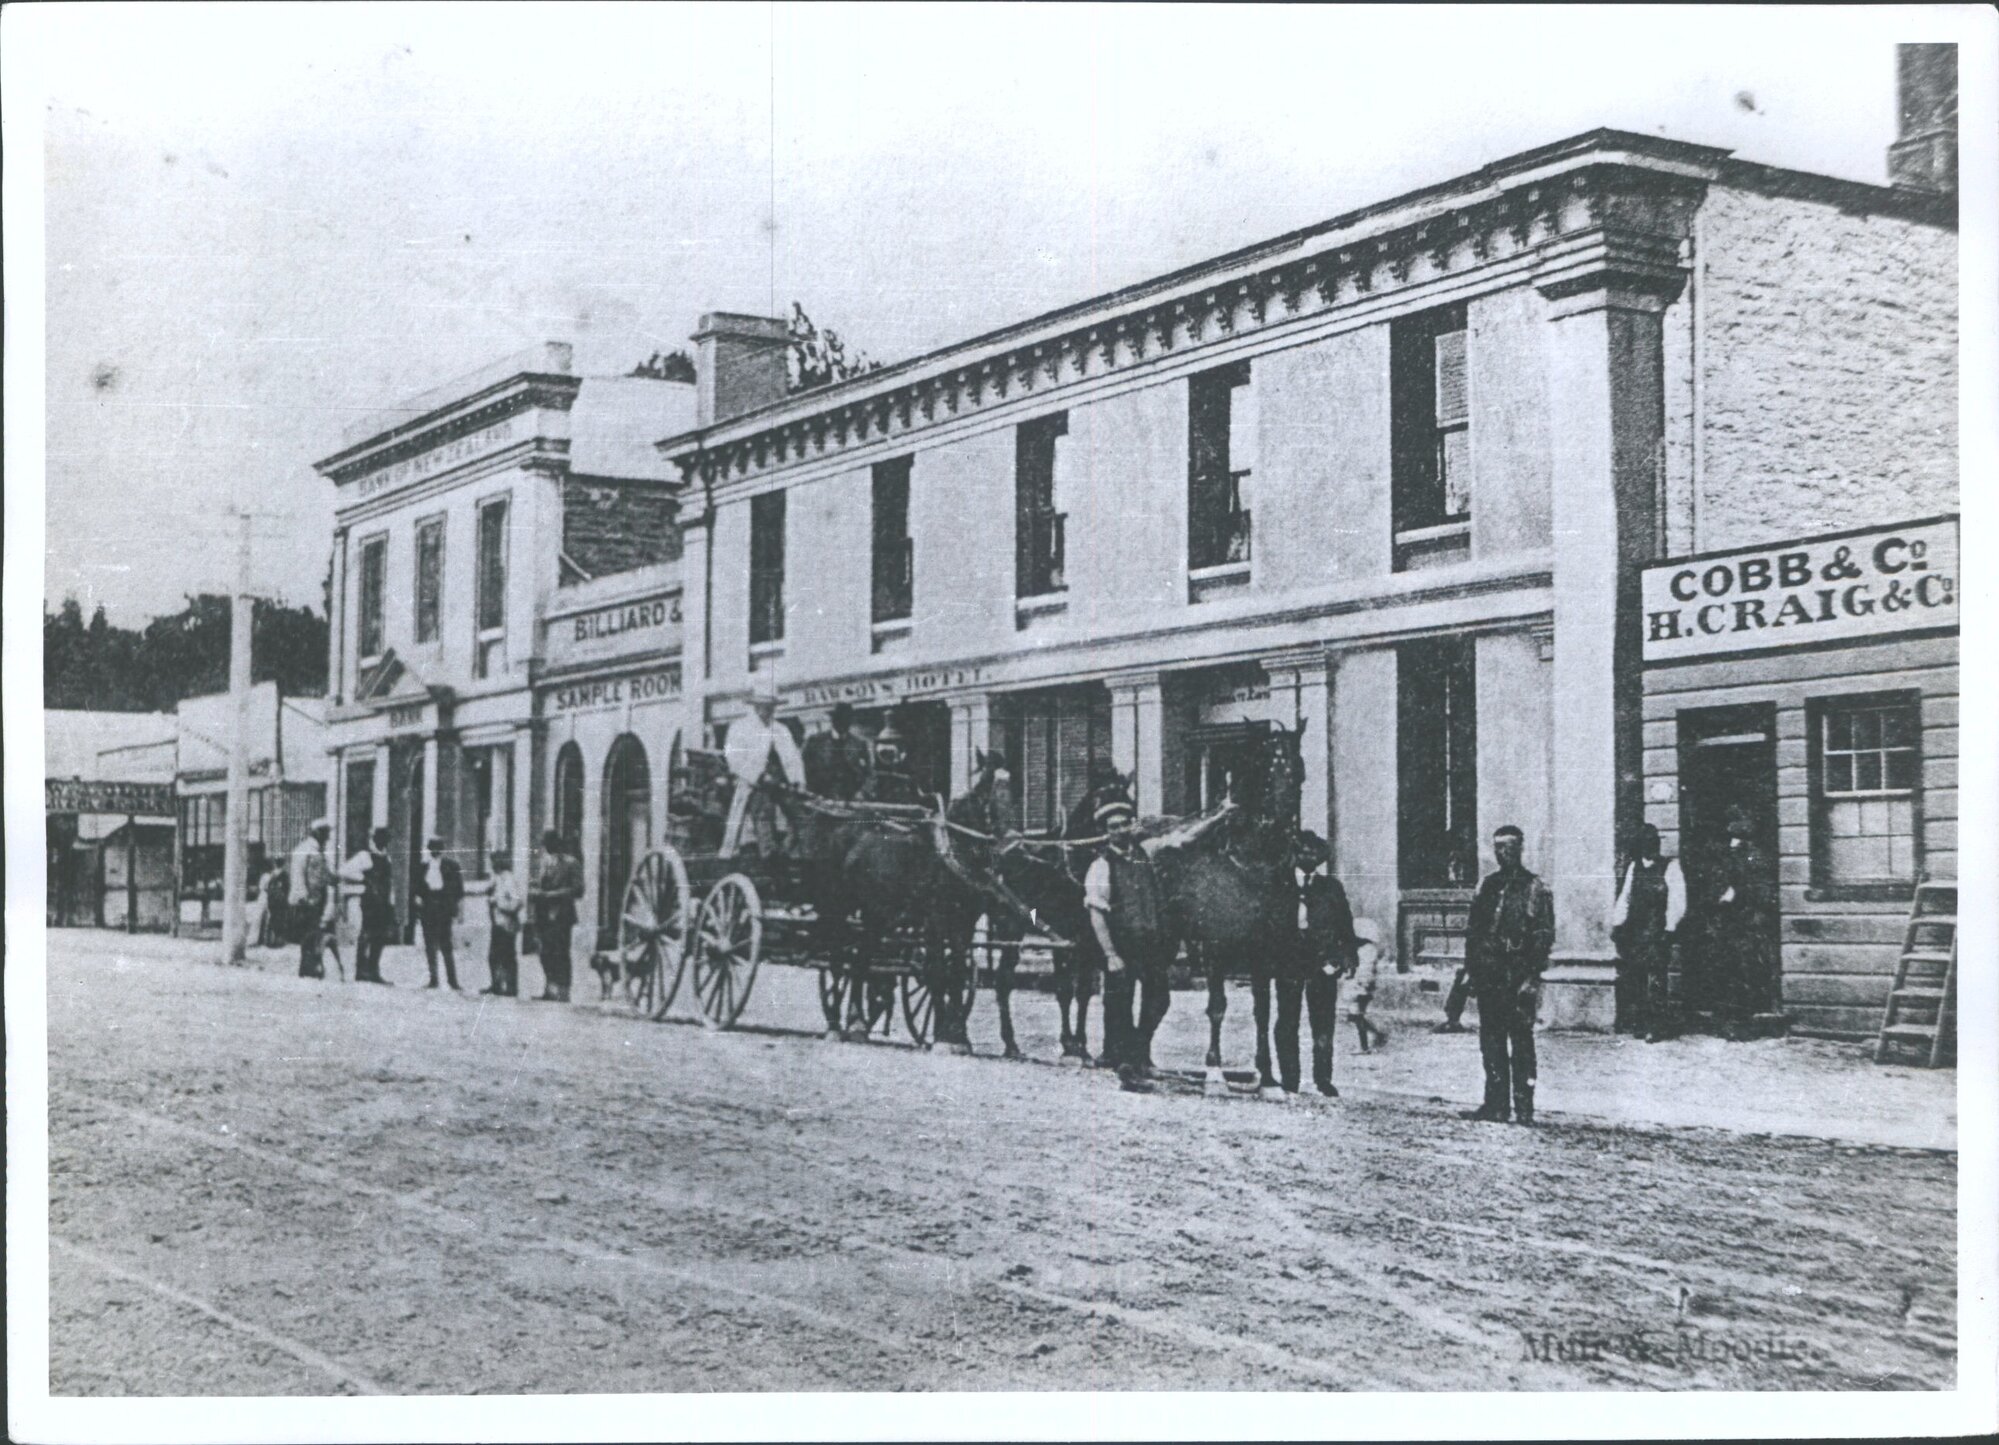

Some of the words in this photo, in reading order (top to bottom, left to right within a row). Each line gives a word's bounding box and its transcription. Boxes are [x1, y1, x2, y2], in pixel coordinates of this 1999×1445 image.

[1670, 551, 1812, 602] COBB
[1820, 546, 1863, 582] &
[575, 601, 665, 642] BILLIARD
[557, 680, 622, 711] SAMPLE
